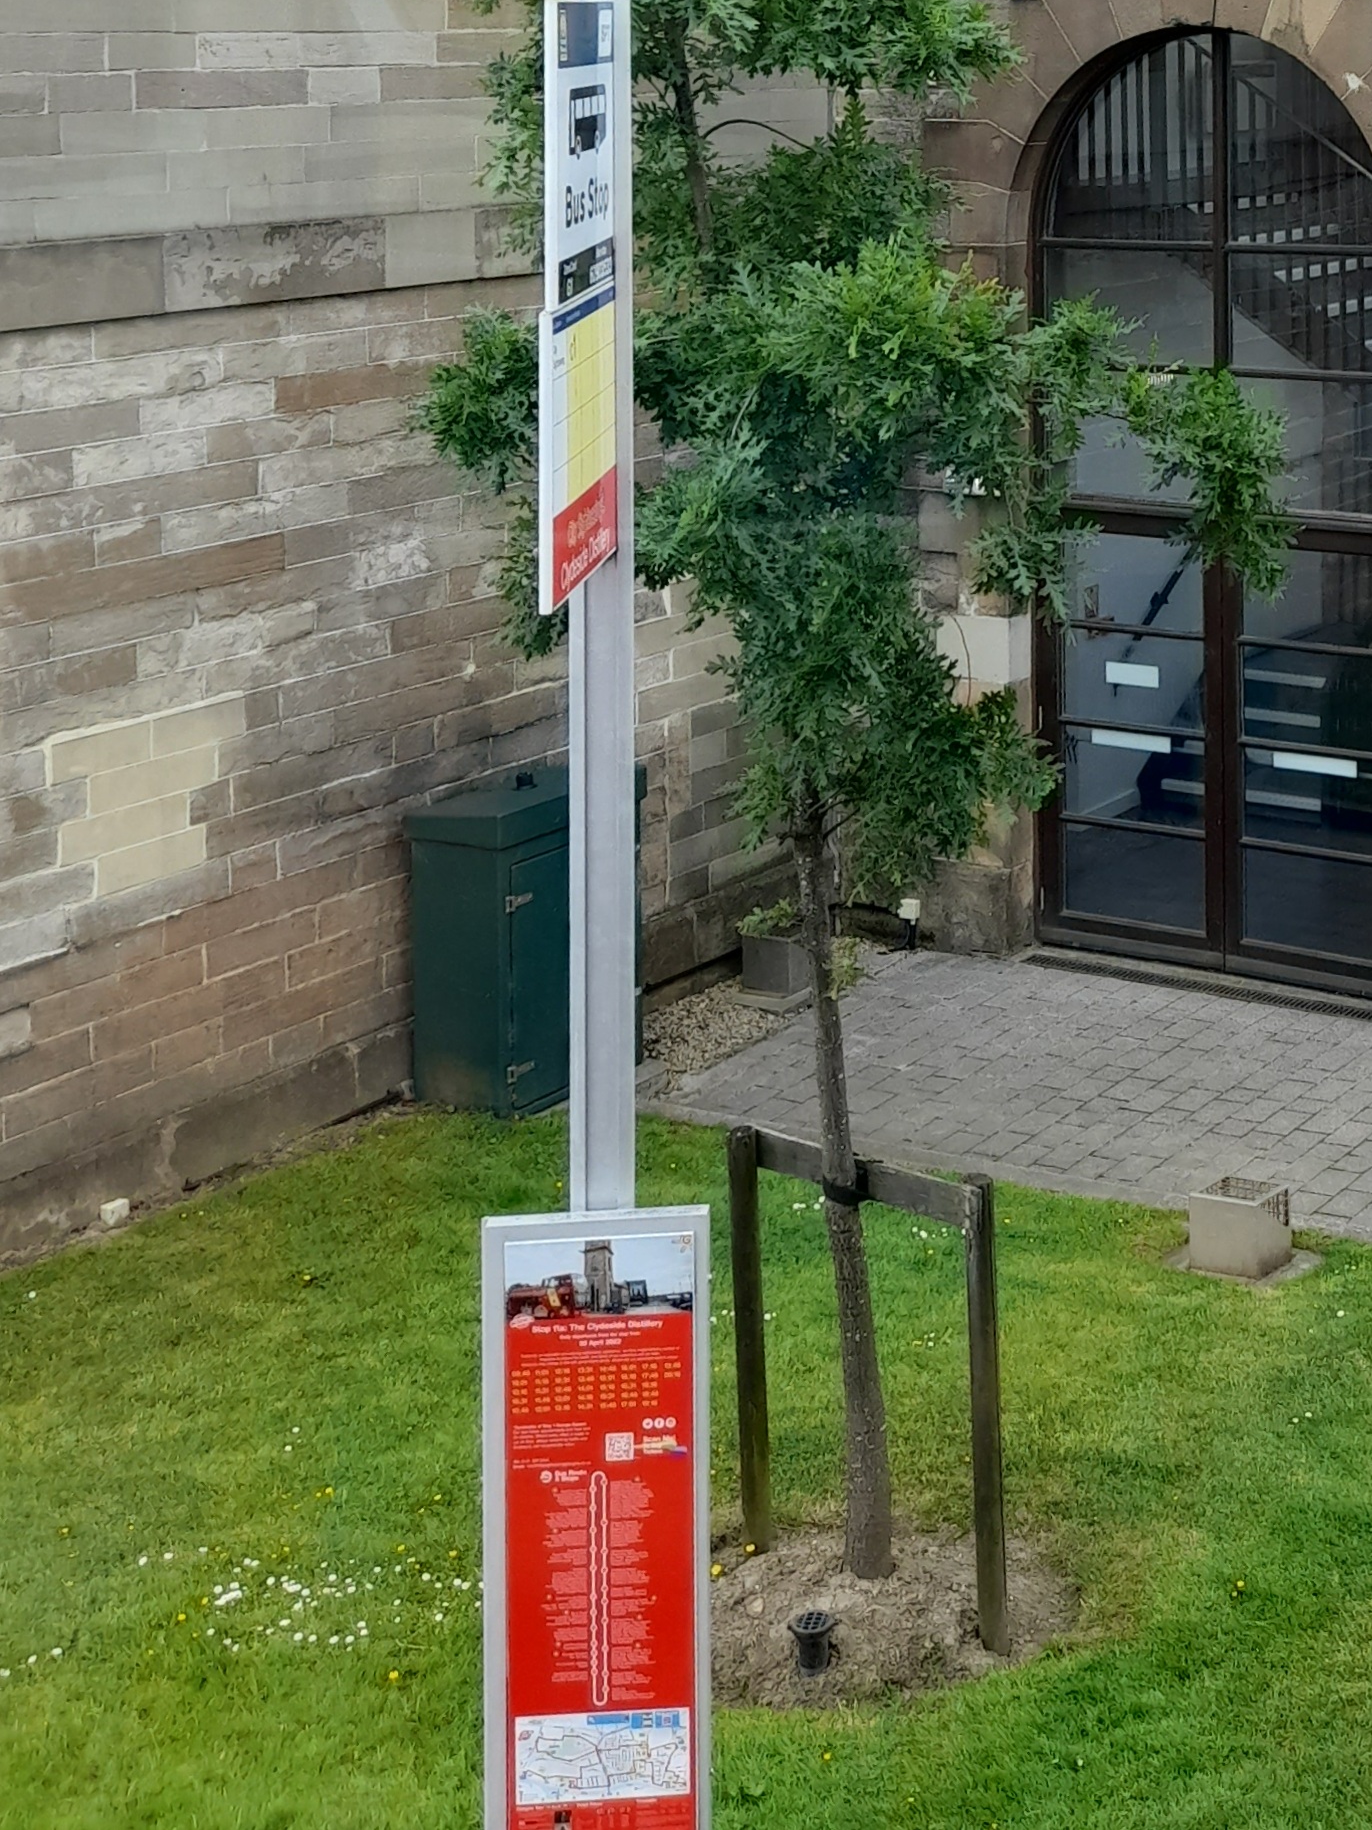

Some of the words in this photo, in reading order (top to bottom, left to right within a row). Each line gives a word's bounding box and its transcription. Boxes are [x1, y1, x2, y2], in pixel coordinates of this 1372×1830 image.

[565, 185, 585, 229] Bus
[588, 176, 609, 221] Stop
[569, 1323, 585, 1332] The
